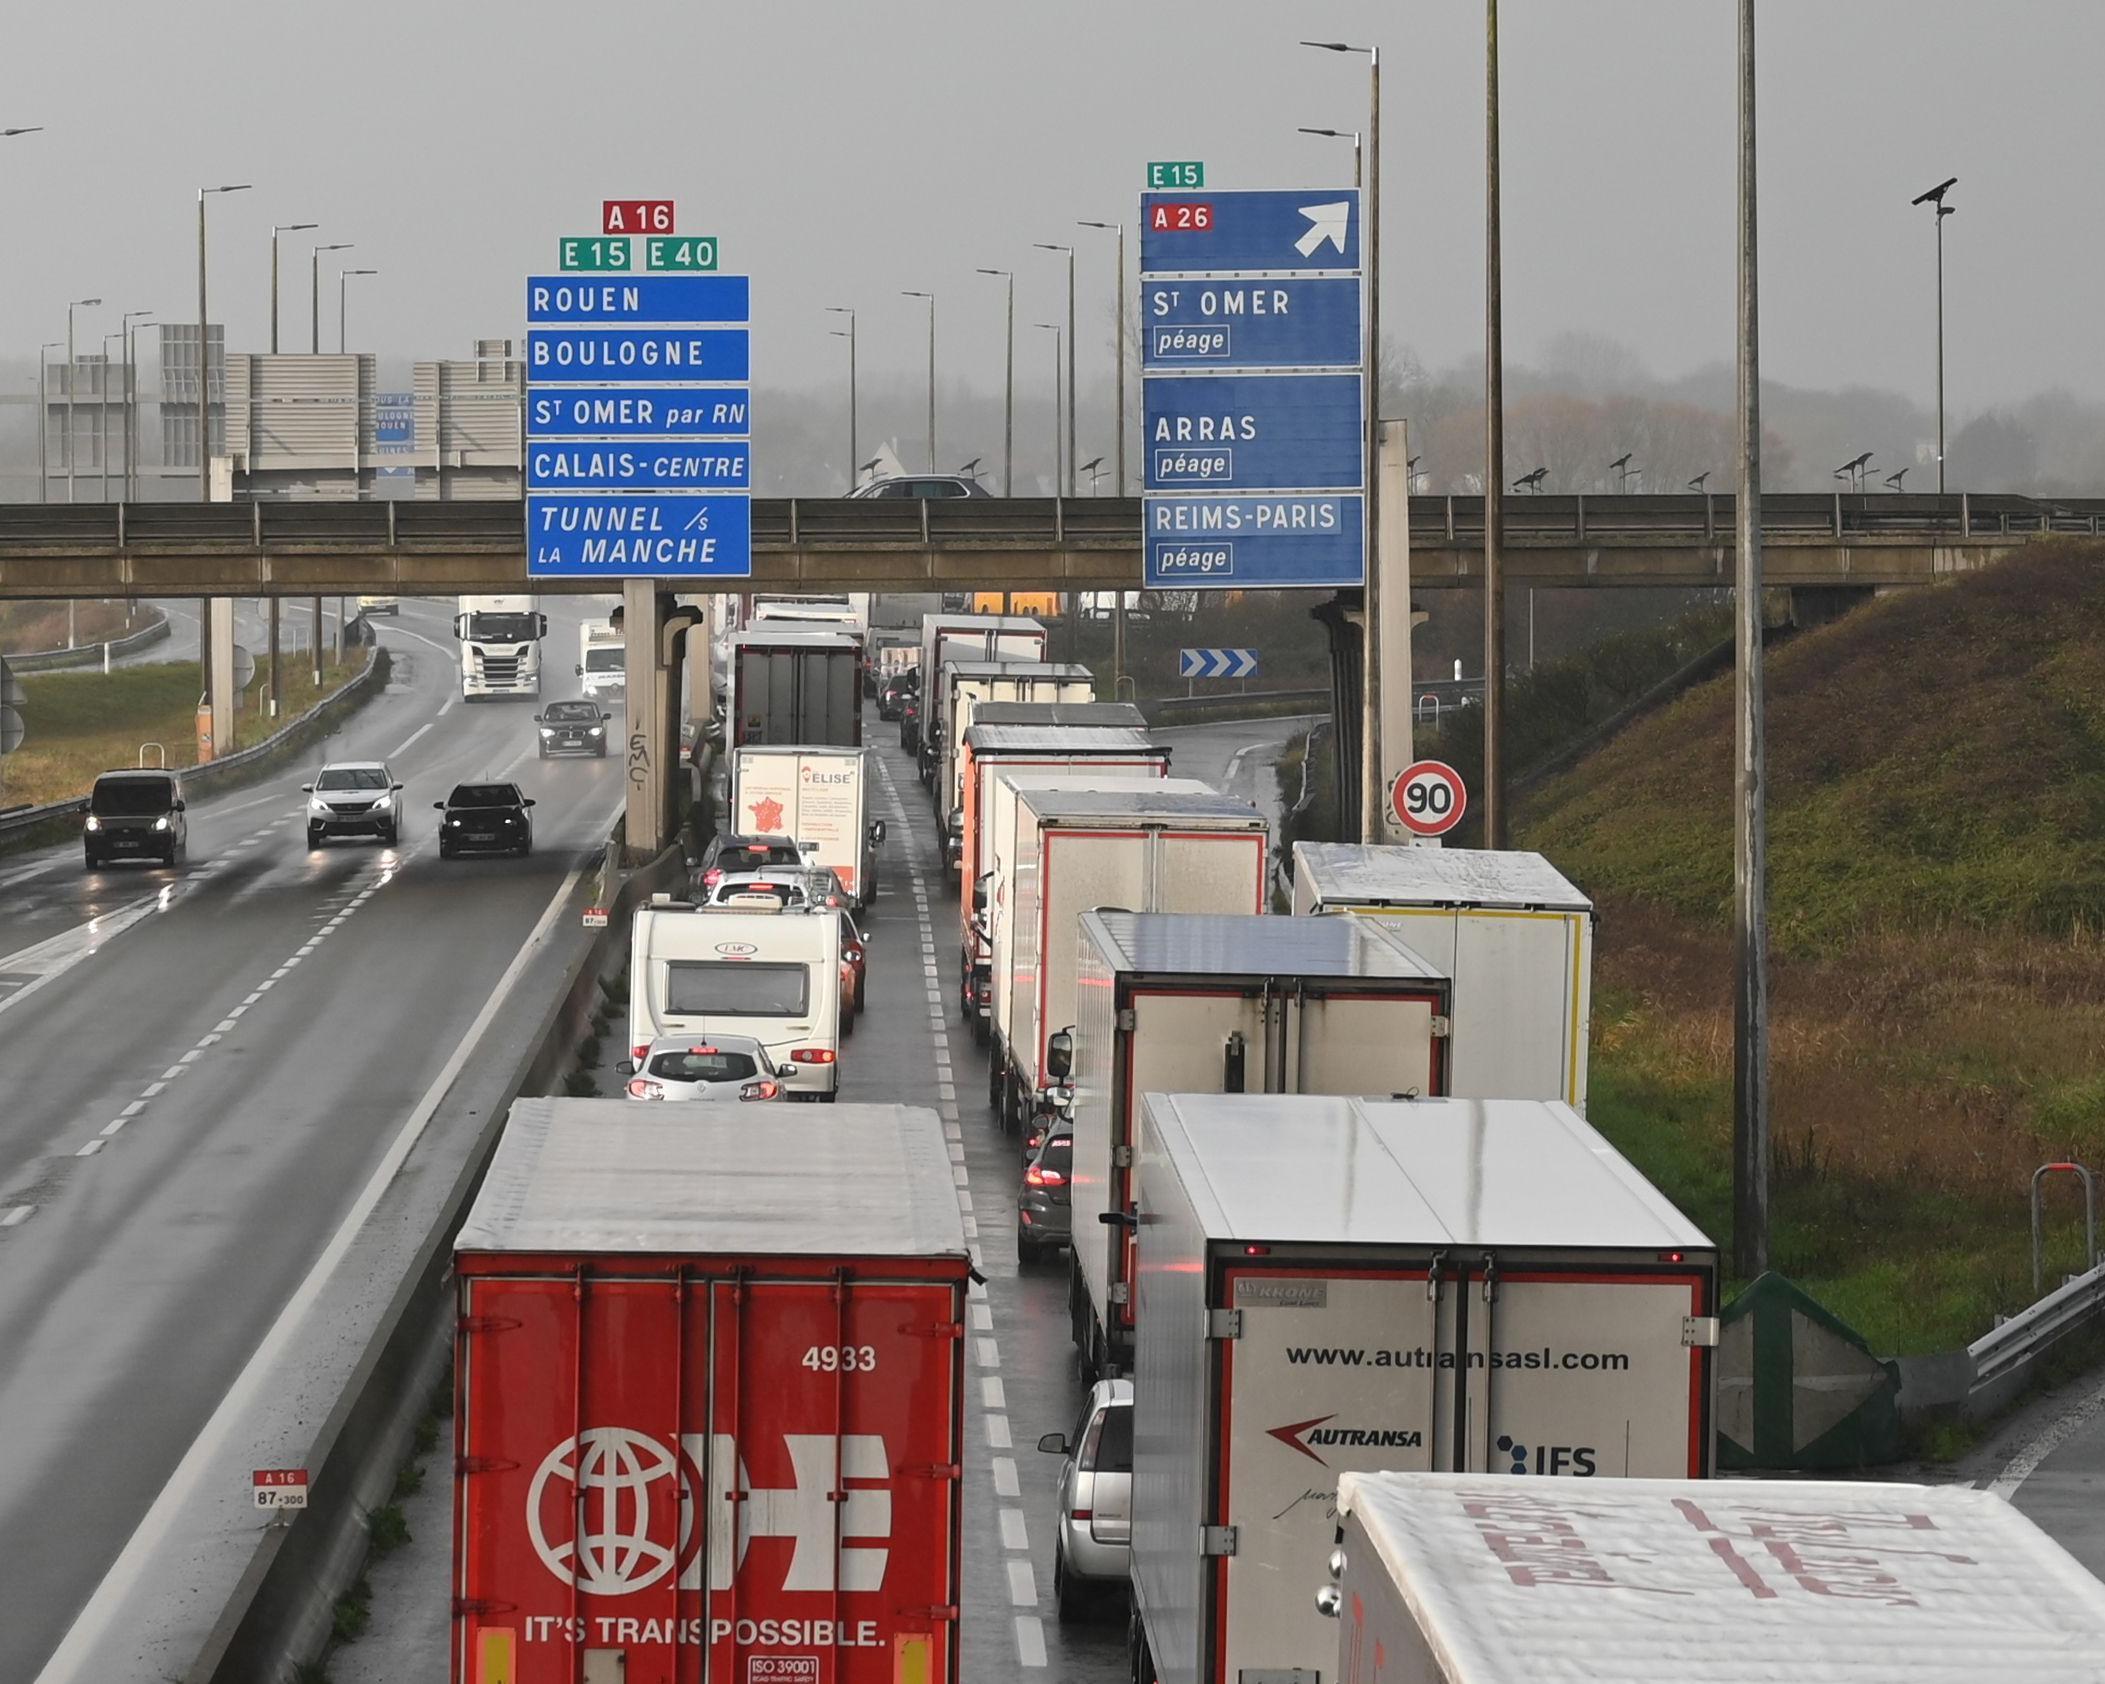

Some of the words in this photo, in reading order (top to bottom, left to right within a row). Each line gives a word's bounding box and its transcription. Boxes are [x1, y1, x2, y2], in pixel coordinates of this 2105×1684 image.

[1153, 165, 1165, 186] E
[1171, 165, 1198, 186] 15
[608, 205, 625, 230] A
[636, 205, 670, 230] 16
[1154, 207, 1168, 228] A
[1177, 207, 1209, 228] 26
[565, 242, 578, 267] E
[591, 242, 626, 267] 15
[651, 242, 664, 267] E
[674, 242, 713, 267] 40
[534, 286, 640, 312] ROUEN
[1200, 289, 1290, 316] OMER
[534, 340, 703, 366] BOULOGNE
[1158, 329, 1224, 356] péage
[574, 399, 654, 425] OMER
[665, 406, 703, 429] par
[712, 403, 746, 425] RN
[1155, 415, 1257, 442] ARRAS
[1160, 452, 1226, 480] péage
[541, 506, 664, 532] TUNNEL
[1156, 503, 1336, 530] REIMS-PARIS
[538, 547, 562, 564] LA
[581, 538, 717, 564] MANCHE
[1162, 547, 1228, 574] péage
[812, 773, 851, 784] ELISE
[1407, 782, 1452, 814] 90
[801, 1345, 877, 1373] 4933
[1286, 1345, 1629, 1371] www.autransasl.com
[1307, 1427, 1422, 1449] AUTRANSA
[1536, 1445, 1596, 1478] IFS
[265, 1473, 273, 1483] A
[279, 1473, 295, 1483] 16
[524, 1615, 587, 1644] IT'S
[595, 1617, 887, 1648] TRANSPOSSIBLE.
[752, 1660, 775, 1674] ISO
[776, 1660, 815, 1674] 39001
